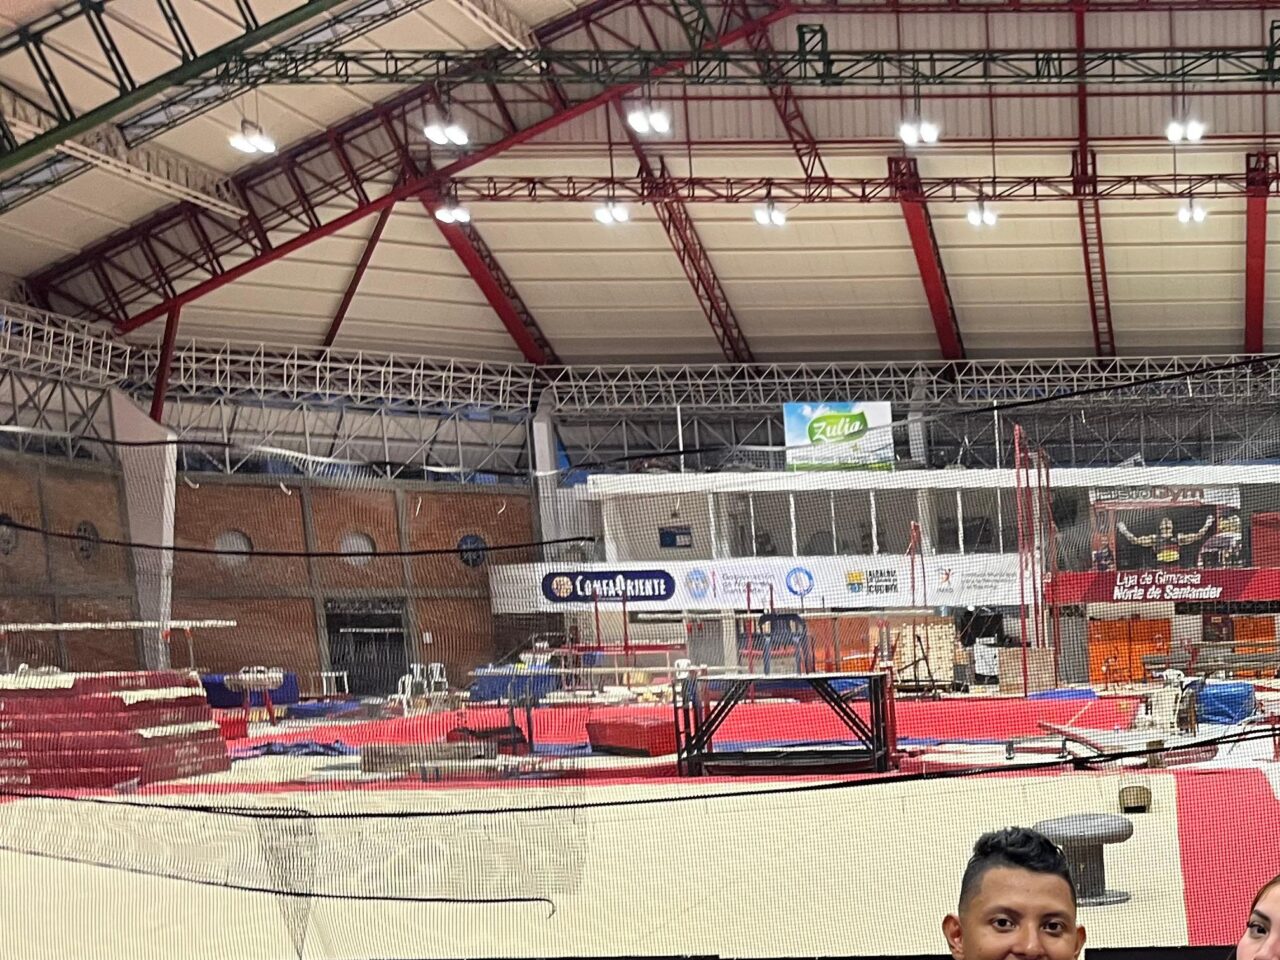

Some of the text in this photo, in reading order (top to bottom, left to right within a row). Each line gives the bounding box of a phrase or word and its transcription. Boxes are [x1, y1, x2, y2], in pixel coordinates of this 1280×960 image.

[813, 417, 864, 441] Zulia
[1116, 572, 1138, 587] Liga
[1139, 573, 1153, 584] de
[1113, 584, 1222, 600] Norte de Santander
